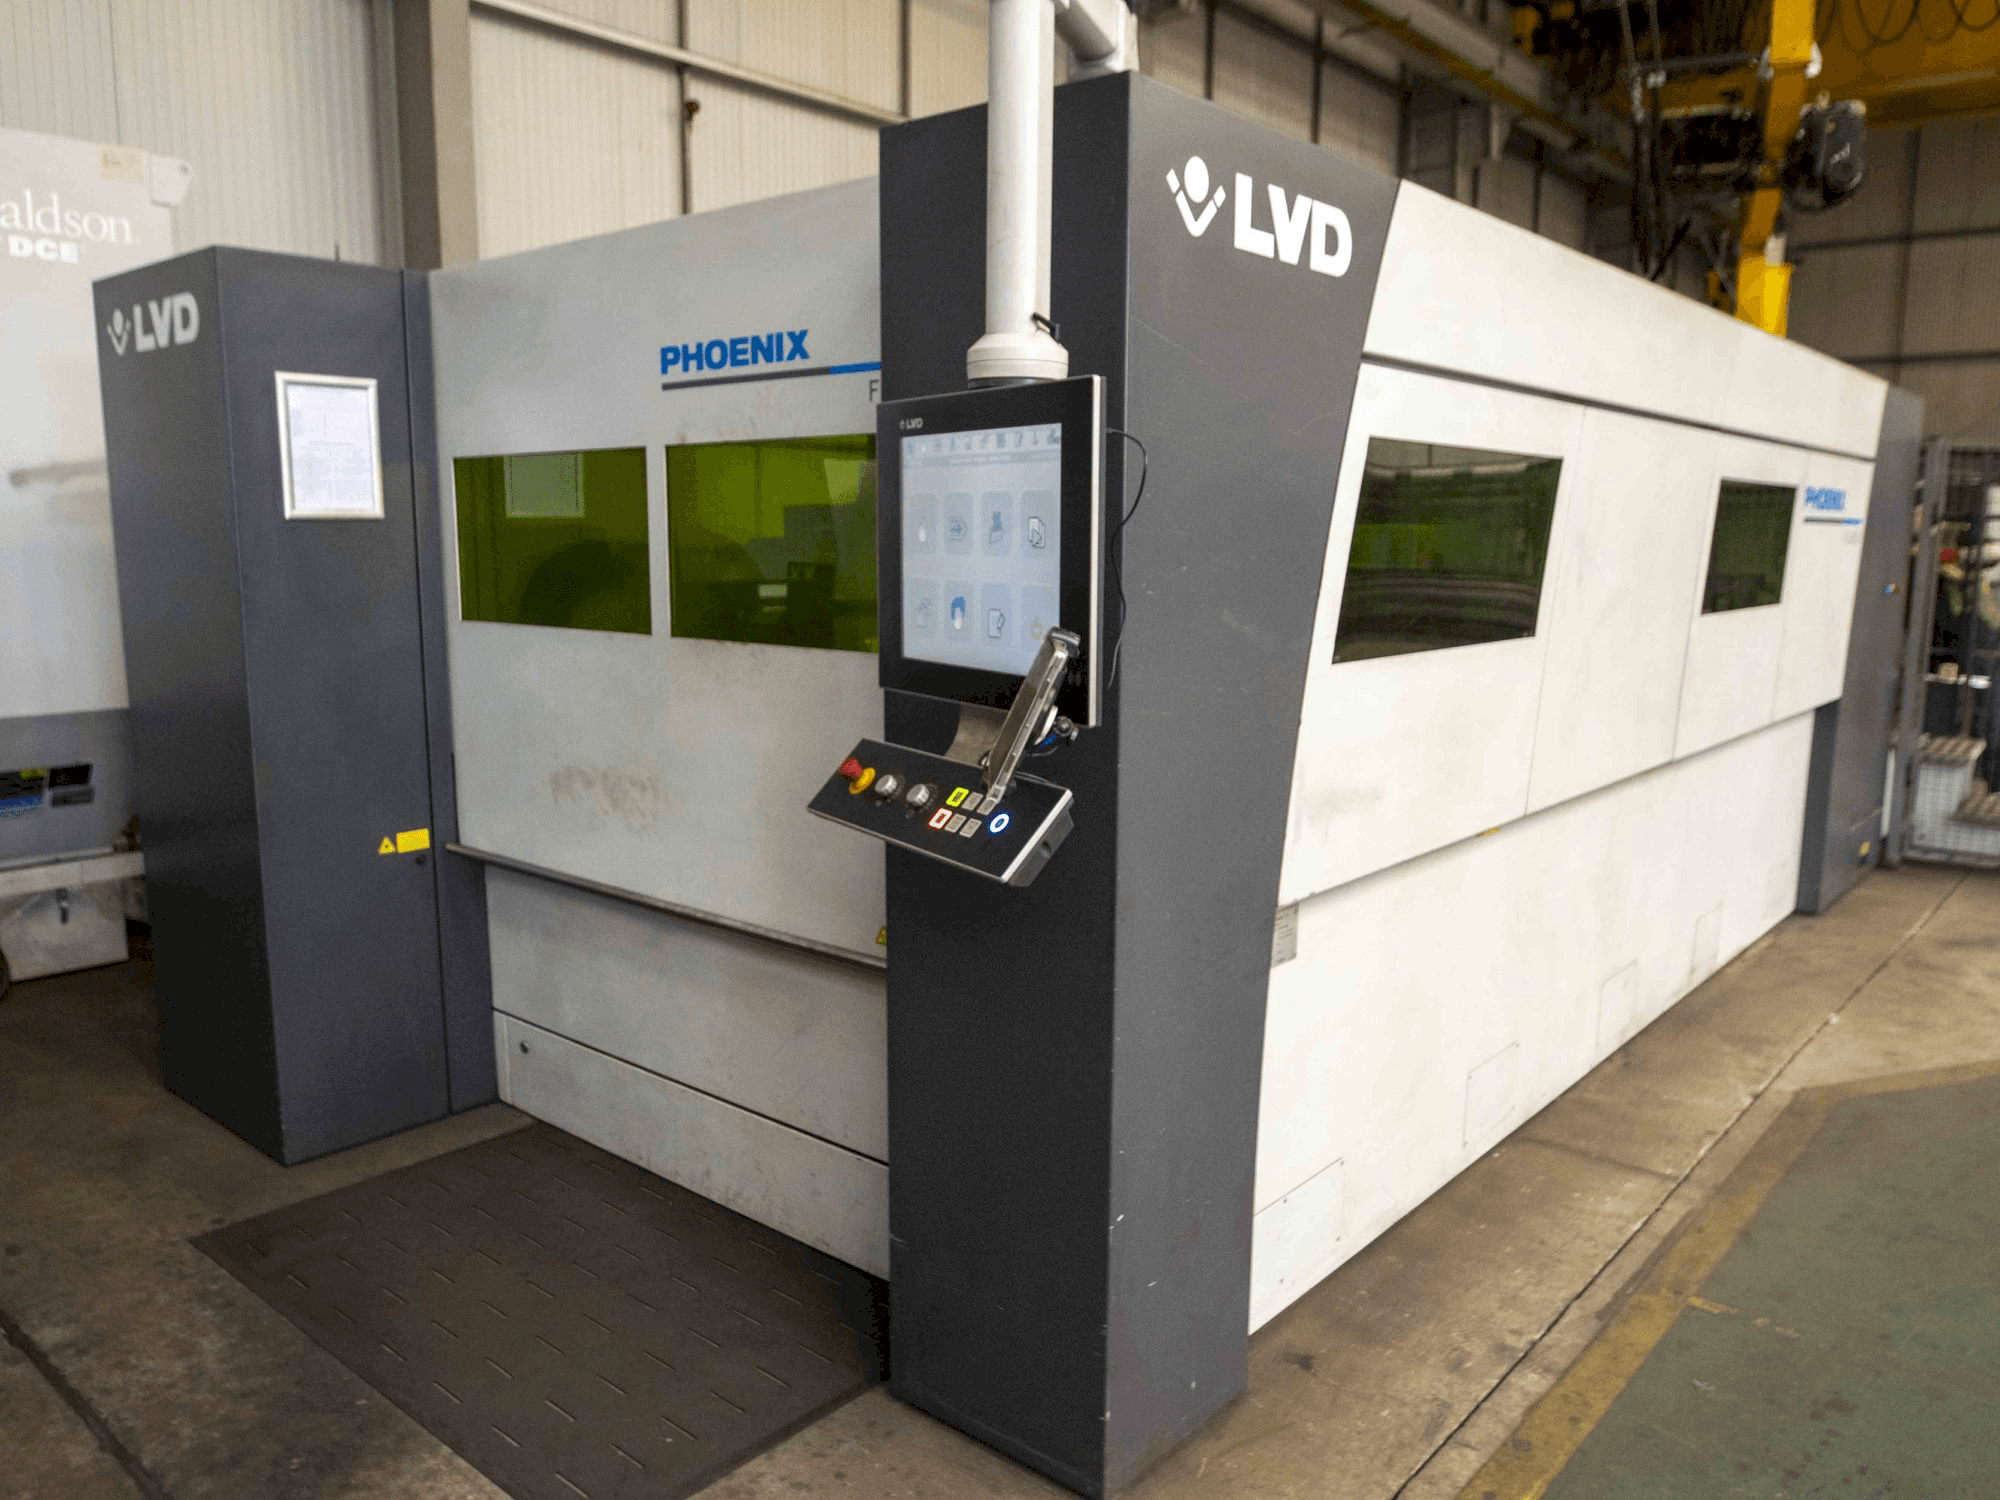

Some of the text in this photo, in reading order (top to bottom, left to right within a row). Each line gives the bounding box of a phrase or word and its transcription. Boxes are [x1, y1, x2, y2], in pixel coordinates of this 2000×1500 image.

[1234, 171, 1353, 278] LVD
[133, 291, 200, 352] LVD
[660, 328, 810, 376] PHOENIX
[906, 417, 923, 429] LVD
